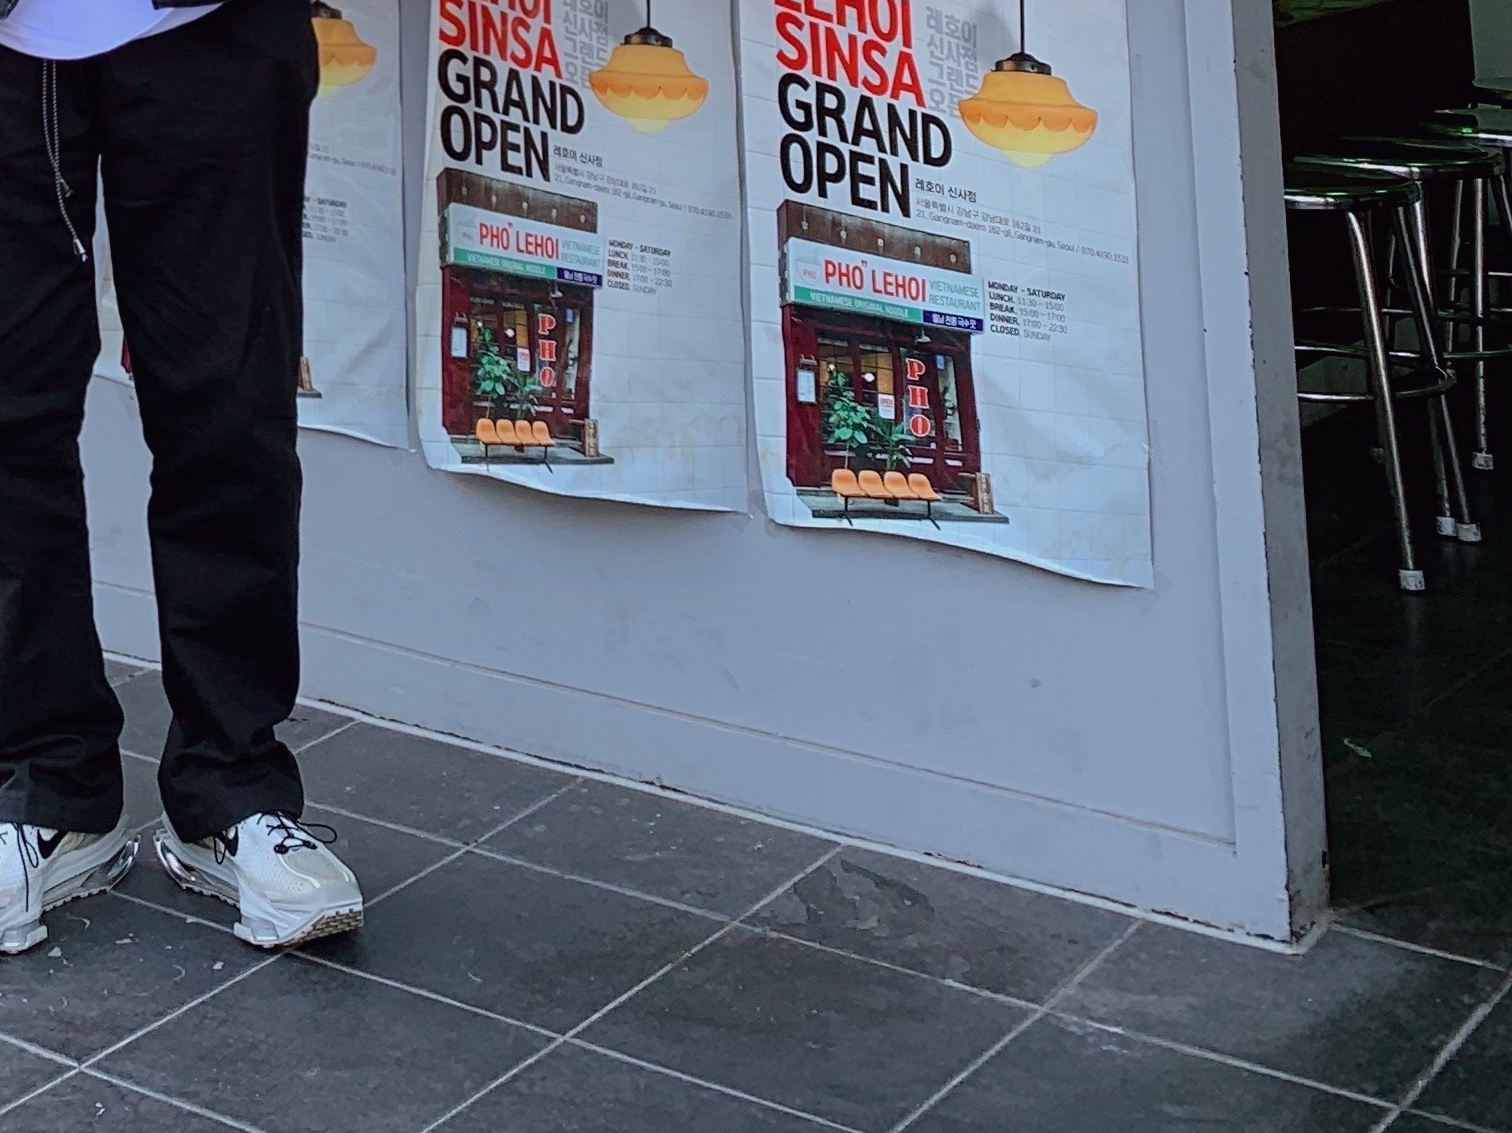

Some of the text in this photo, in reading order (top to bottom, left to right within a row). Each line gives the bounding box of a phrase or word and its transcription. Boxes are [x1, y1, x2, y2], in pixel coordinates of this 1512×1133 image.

[926, 6, 977, 48] 레호이
[775, 11, 926, 108] SINSA
[927, 34, 978, 73] 신사점
[438, 49, 585, 135] GRAND
[777, 72, 952, 167] GRAND
[440, 104, 551, 182] OPEN
[780, 133, 911, 218] OPEN
[915, 177, 977, 203] 레호이 신사점
[516, 230, 559, 260] LEHOI
[872, 269, 926, 302] LEHOI
[929, 279, 979, 298] VIETNAMESE
[929, 293, 980, 311] RESTAURANT
[988, 281, 1018, 293] MONDAY
[1027, 287, 1066, 301] SATURDAY
[538, 313, 556, 387] PHO
[905, 357, 931, 437] PHO
